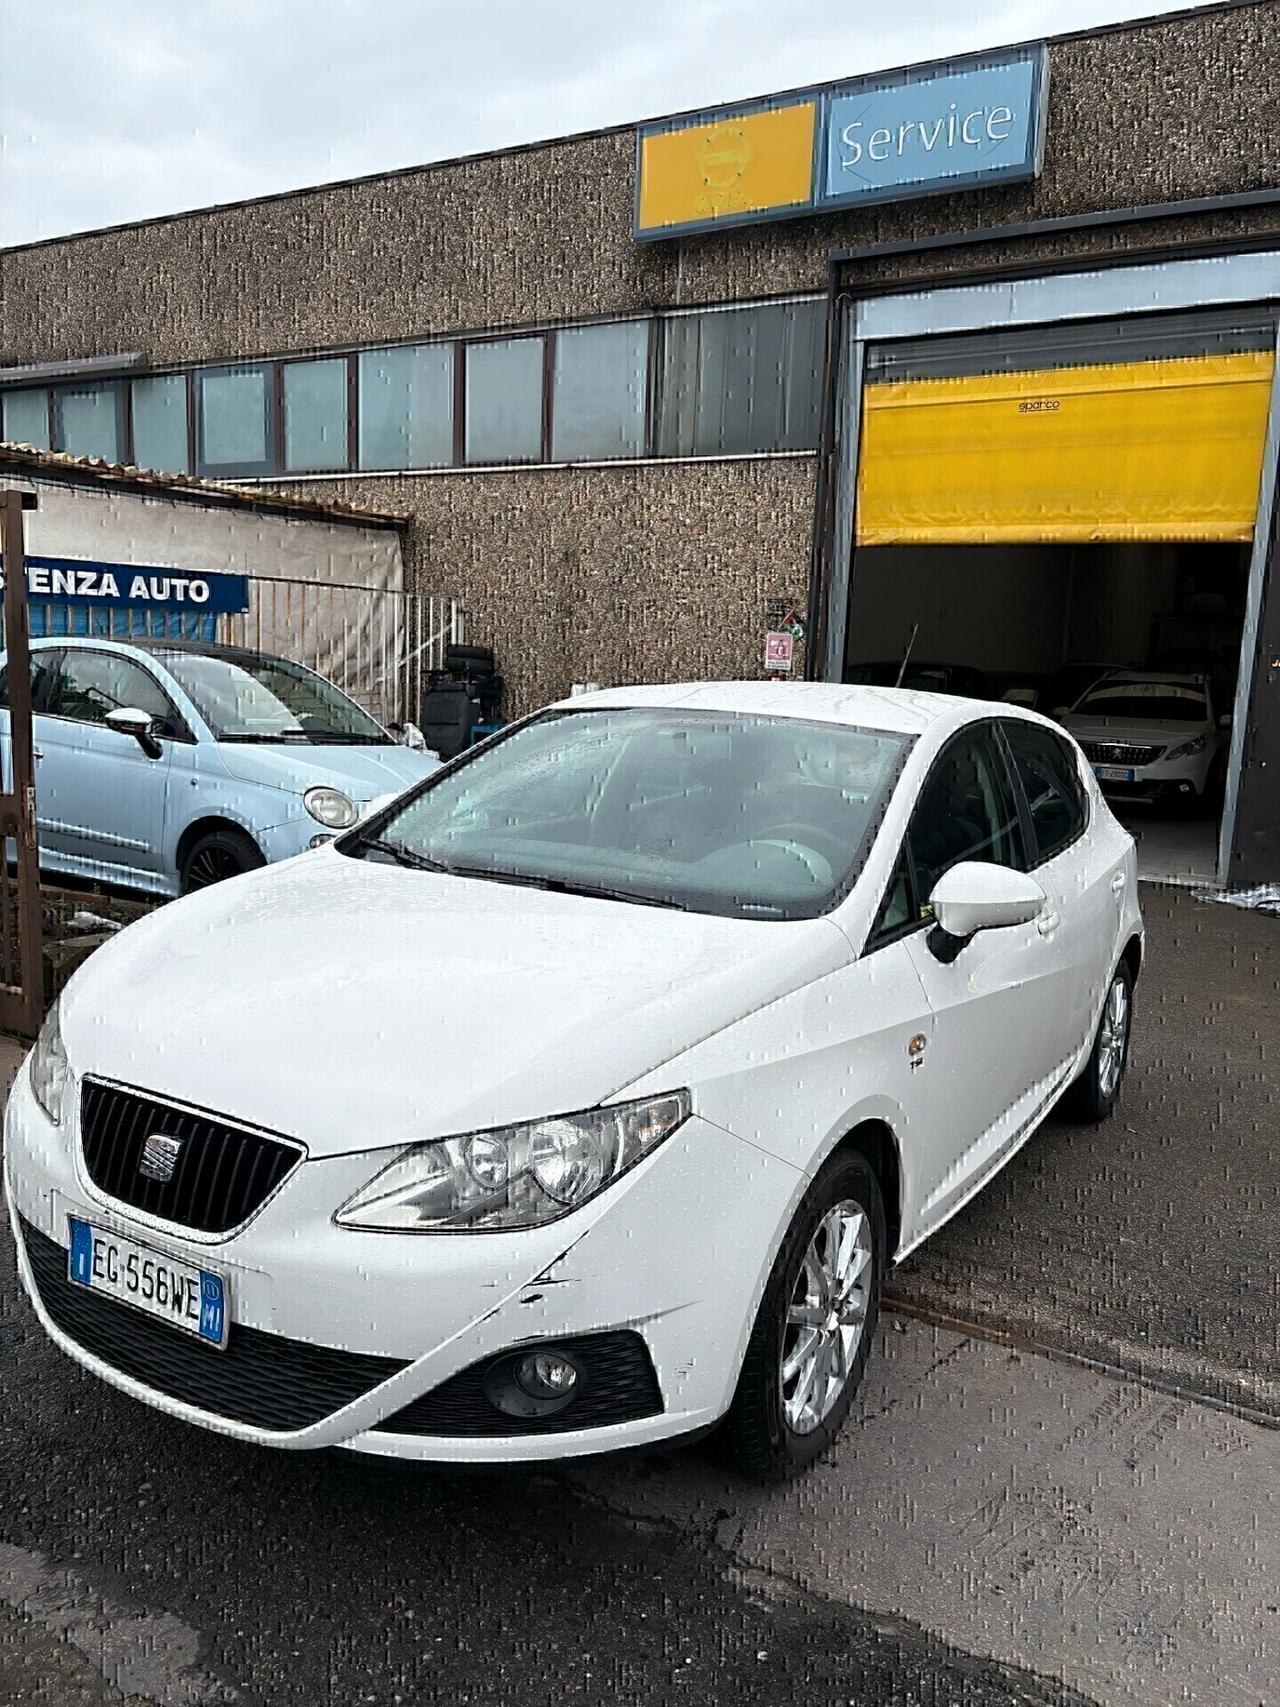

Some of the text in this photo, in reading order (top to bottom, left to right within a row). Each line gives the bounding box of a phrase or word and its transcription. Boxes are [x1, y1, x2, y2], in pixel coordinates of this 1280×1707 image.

[842, 103, 1012, 167] Service
[1019, 400, 1060, 413] sparco
[0, 566, 210, 603] ENZA AUTO
